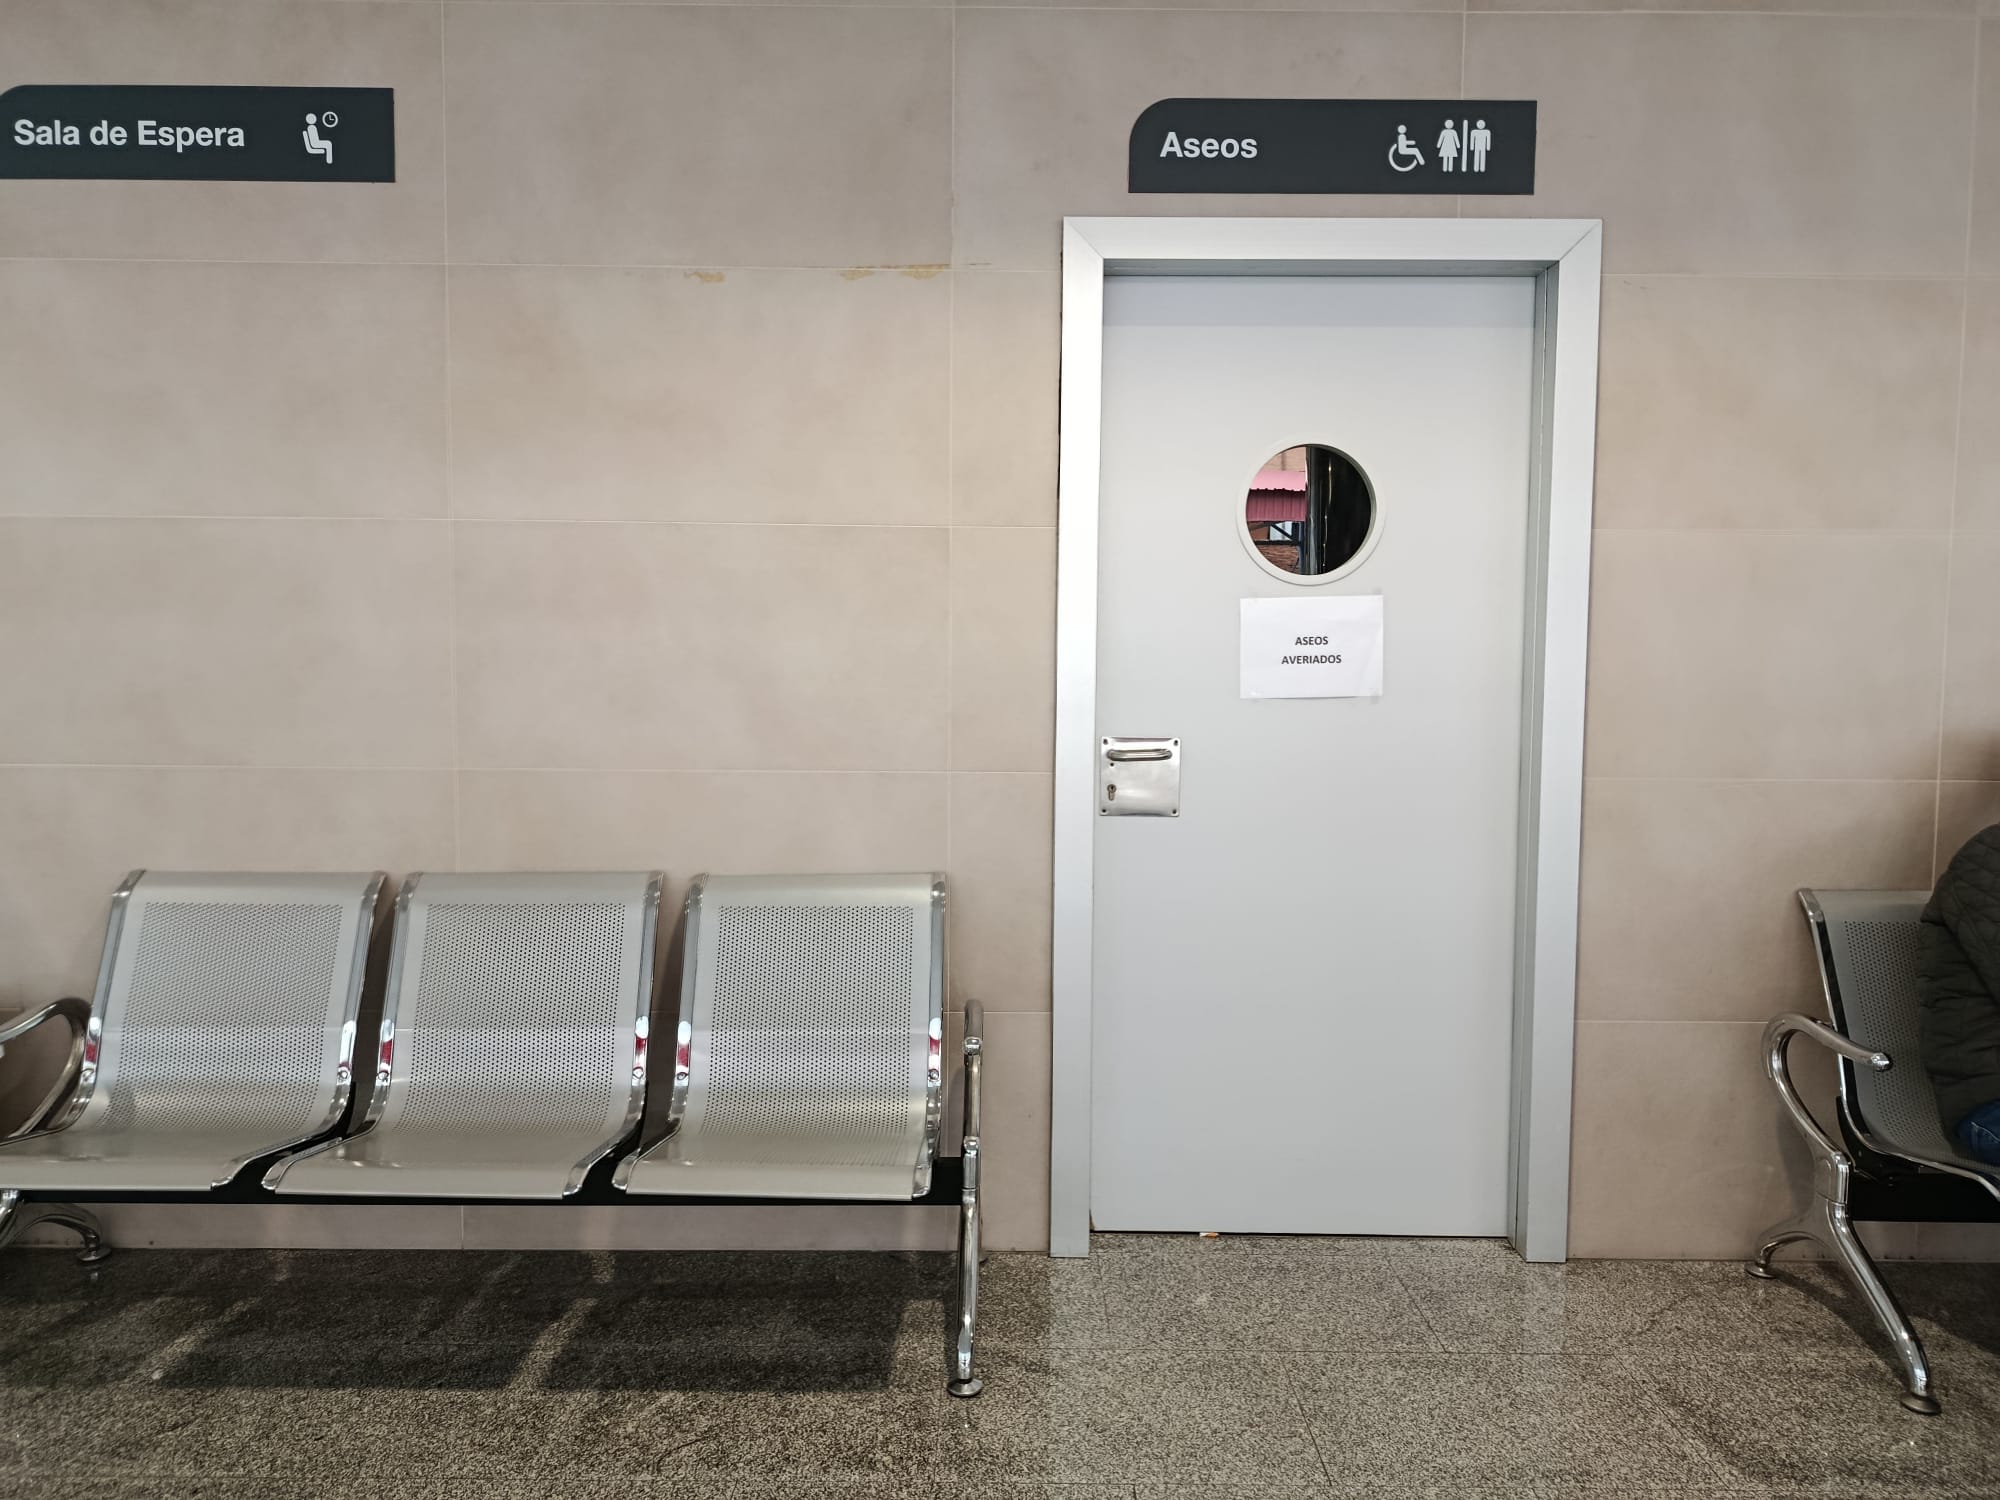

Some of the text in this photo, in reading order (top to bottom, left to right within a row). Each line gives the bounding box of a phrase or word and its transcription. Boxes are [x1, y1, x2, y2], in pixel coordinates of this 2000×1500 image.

[14, 119, 244, 152] Sala de Espera
[1160, 132, 1257, 158] Aseos
[1295, 636, 1328, 645] ASEOS
[1282, 655, 1341, 664] AVERIADOS
